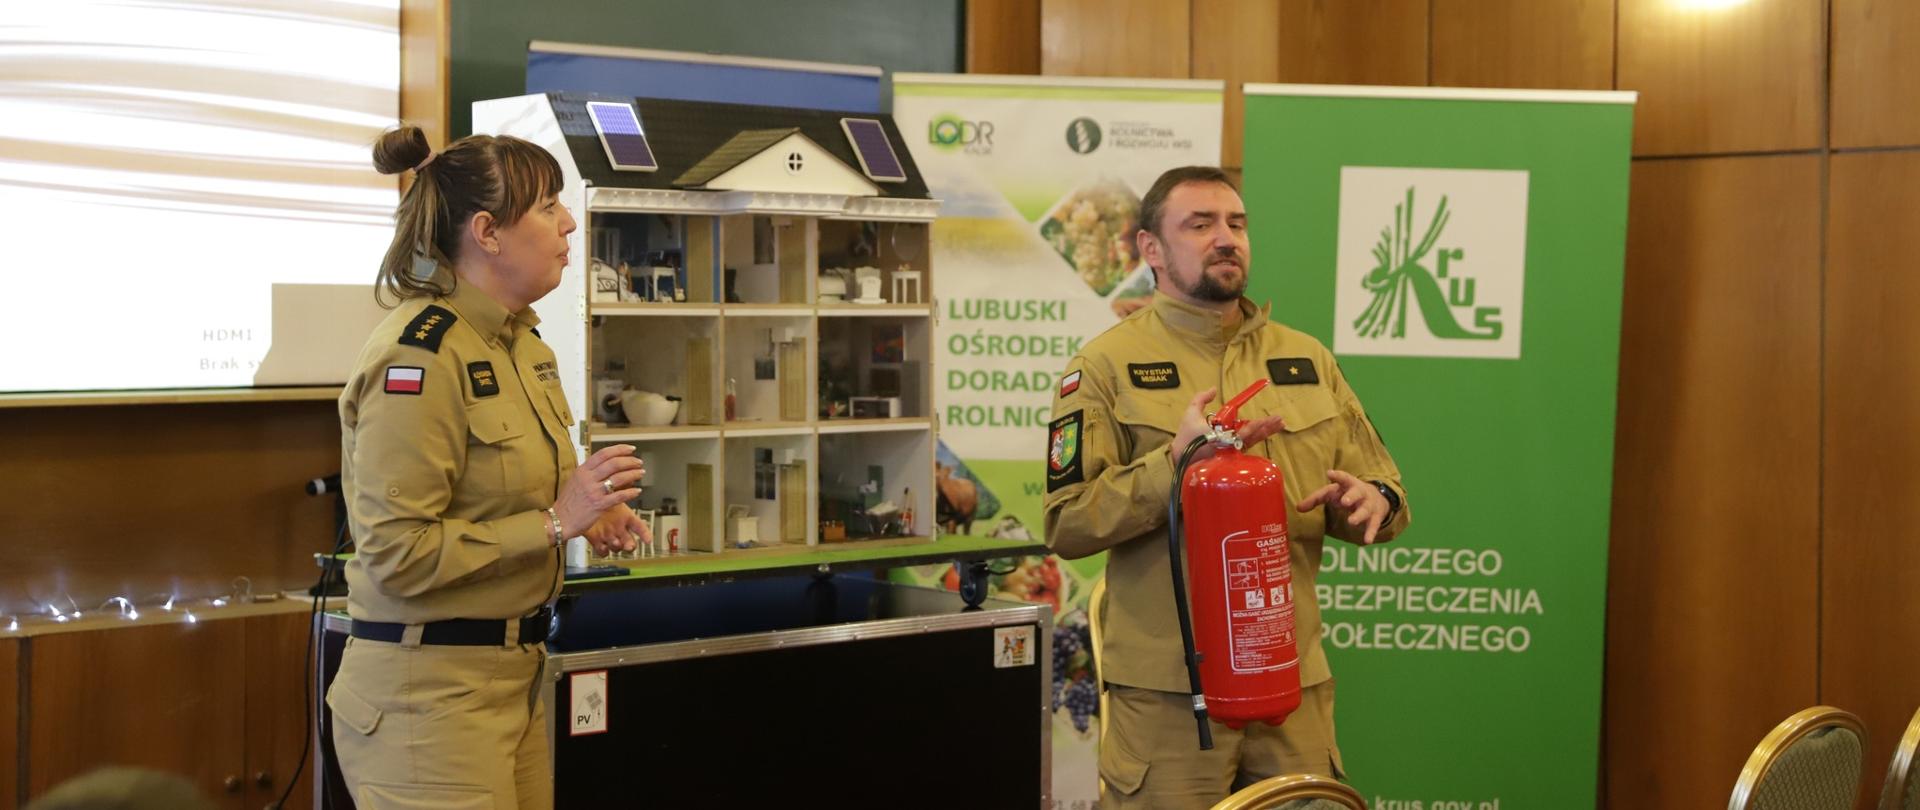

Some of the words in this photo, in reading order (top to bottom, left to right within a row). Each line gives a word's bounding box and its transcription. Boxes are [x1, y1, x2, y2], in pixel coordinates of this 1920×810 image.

[928, 120, 994, 145] LODR
[948, 299, 1067, 322] LUBUSKI
[203, 328, 252, 341] HDMI
[947, 328, 1084, 357] OŚRODEK
[200, 356, 239, 370] Brak
[947, 404, 1051, 427] ROLNIC
[577, 714, 591, 725] PV
[1374, 795, 1500, 810] krusgovpl
